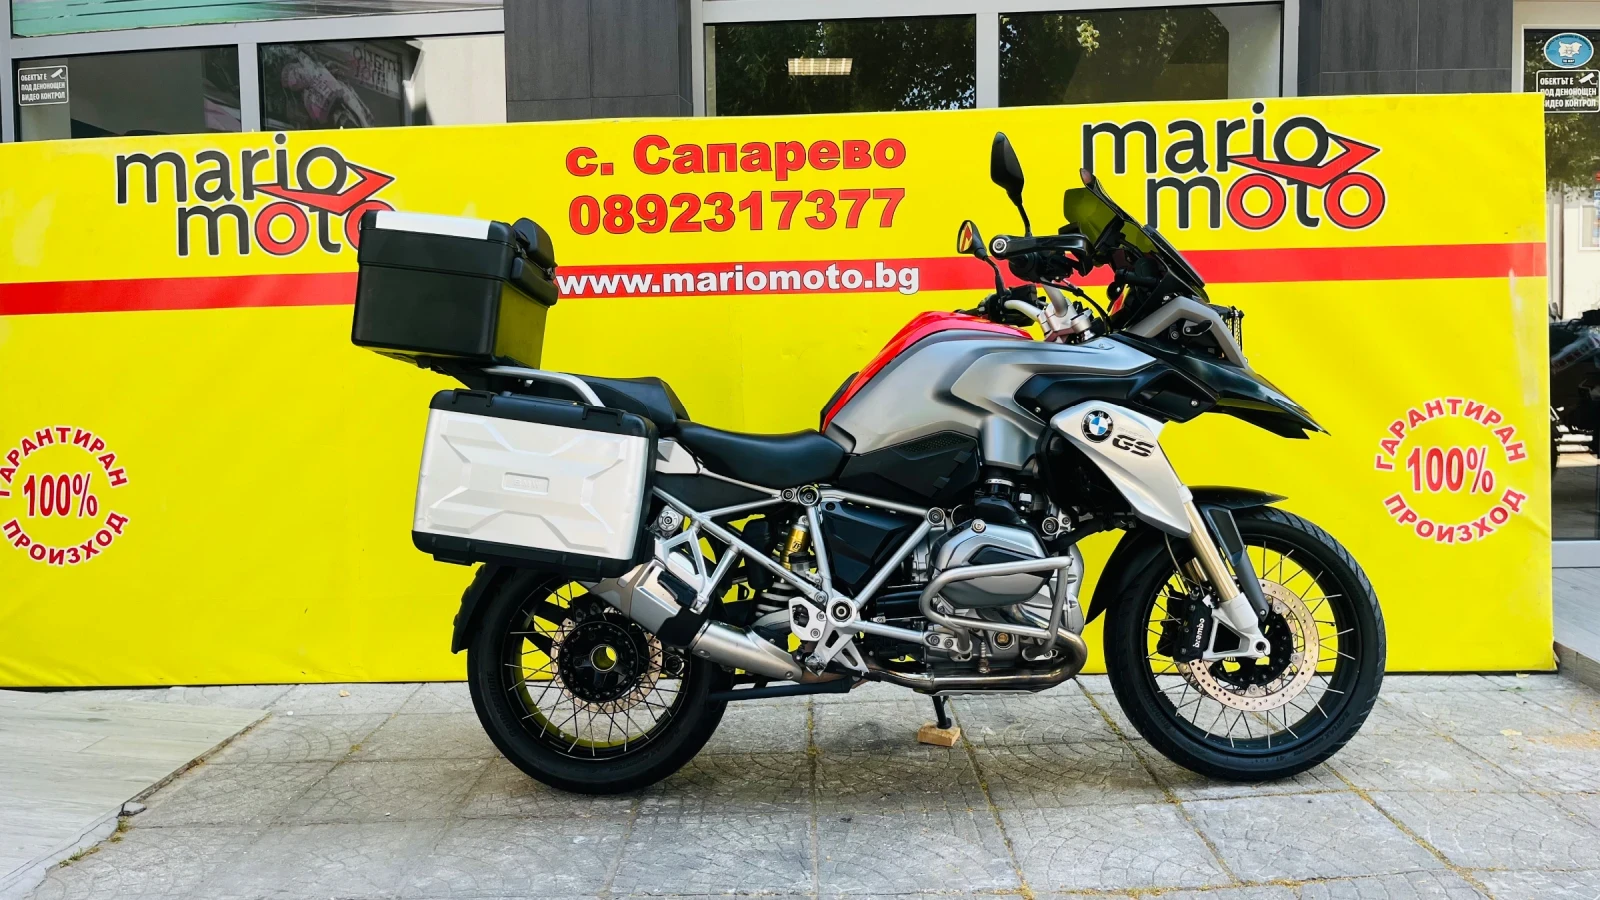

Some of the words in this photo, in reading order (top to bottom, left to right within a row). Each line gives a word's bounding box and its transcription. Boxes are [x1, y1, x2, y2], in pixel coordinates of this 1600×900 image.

[21, 83, 33, 91] ПОД
[33, 82, 65, 91] ДЕНОНОЩЕН
[21, 93, 40, 102] ВИДЕО
[41, 92, 65, 100] КОНТРОЛ
[1544, 99, 1563, 108] ИДЕО
[1564, 99, 1596, 108] КОНТРОЛ
[1555, 88, 1596, 97] ДЕНОНОЩЕН
[1570, 77, 1574, 85] Е
[565, 146, 614, 177] с.
[632, 134, 906, 181] Сапарево
[1082, 102, 1329, 174] mario
[116, 133, 347, 205] mario
[568, 187, 906, 235] 0892317377
[1146, 172, 1385, 229] moto
[555, 262, 919, 295] www.mariomoto.bg
[1112, 434, 1155, 457] GS
[1375, 399, 1526, 470] ГАРАНТИРАН
[1407, 447, 1494, 493] 100%
[23, 473, 98, 517] 100%
[1384, 489, 1526, 543] ПРОИЗХОД
[2, 512, 129, 565] ПРОИЗХОД
[1192, 617, 1205, 648] brembo
